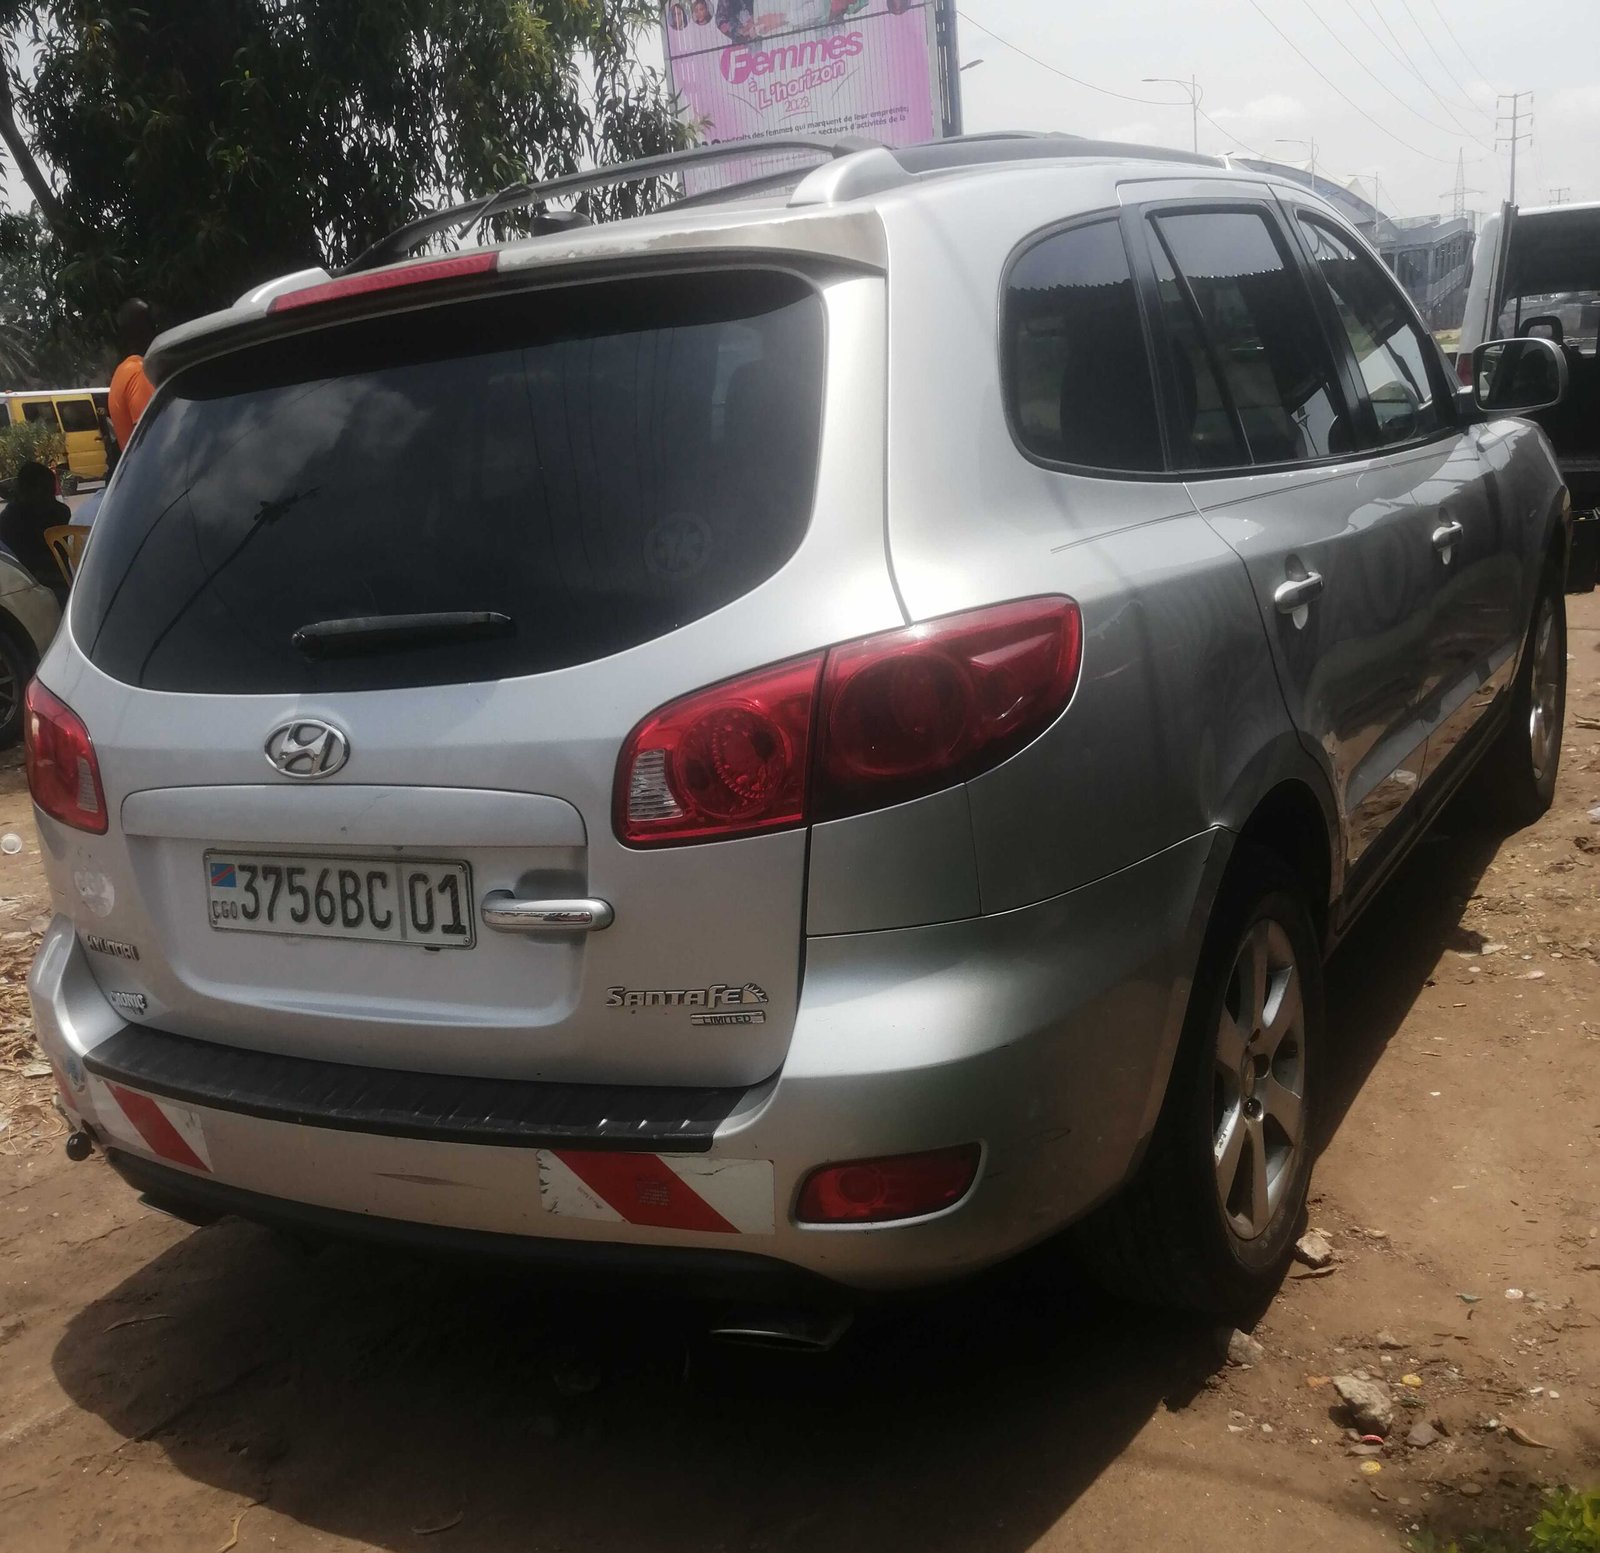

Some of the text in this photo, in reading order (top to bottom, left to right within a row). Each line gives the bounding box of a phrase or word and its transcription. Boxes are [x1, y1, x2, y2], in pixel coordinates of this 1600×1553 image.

[721, 31, 863, 84] Femmes
[758, 60, 846, 110] L'horizon
[765, 126, 794, 137] femmes
[794, 123, 806, 132] qui
[807, 117, 842, 131] marquent
[843, 114, 853, 123] de
[854, 112, 869, 121] leur
[888, 116, 898, 124] de
[899, 113, 906, 121] la
[212, 899, 238, 920] CGO
[238, 863, 467, 935] 3756BC 01
[702, 1014, 752, 1025] LIMITED
